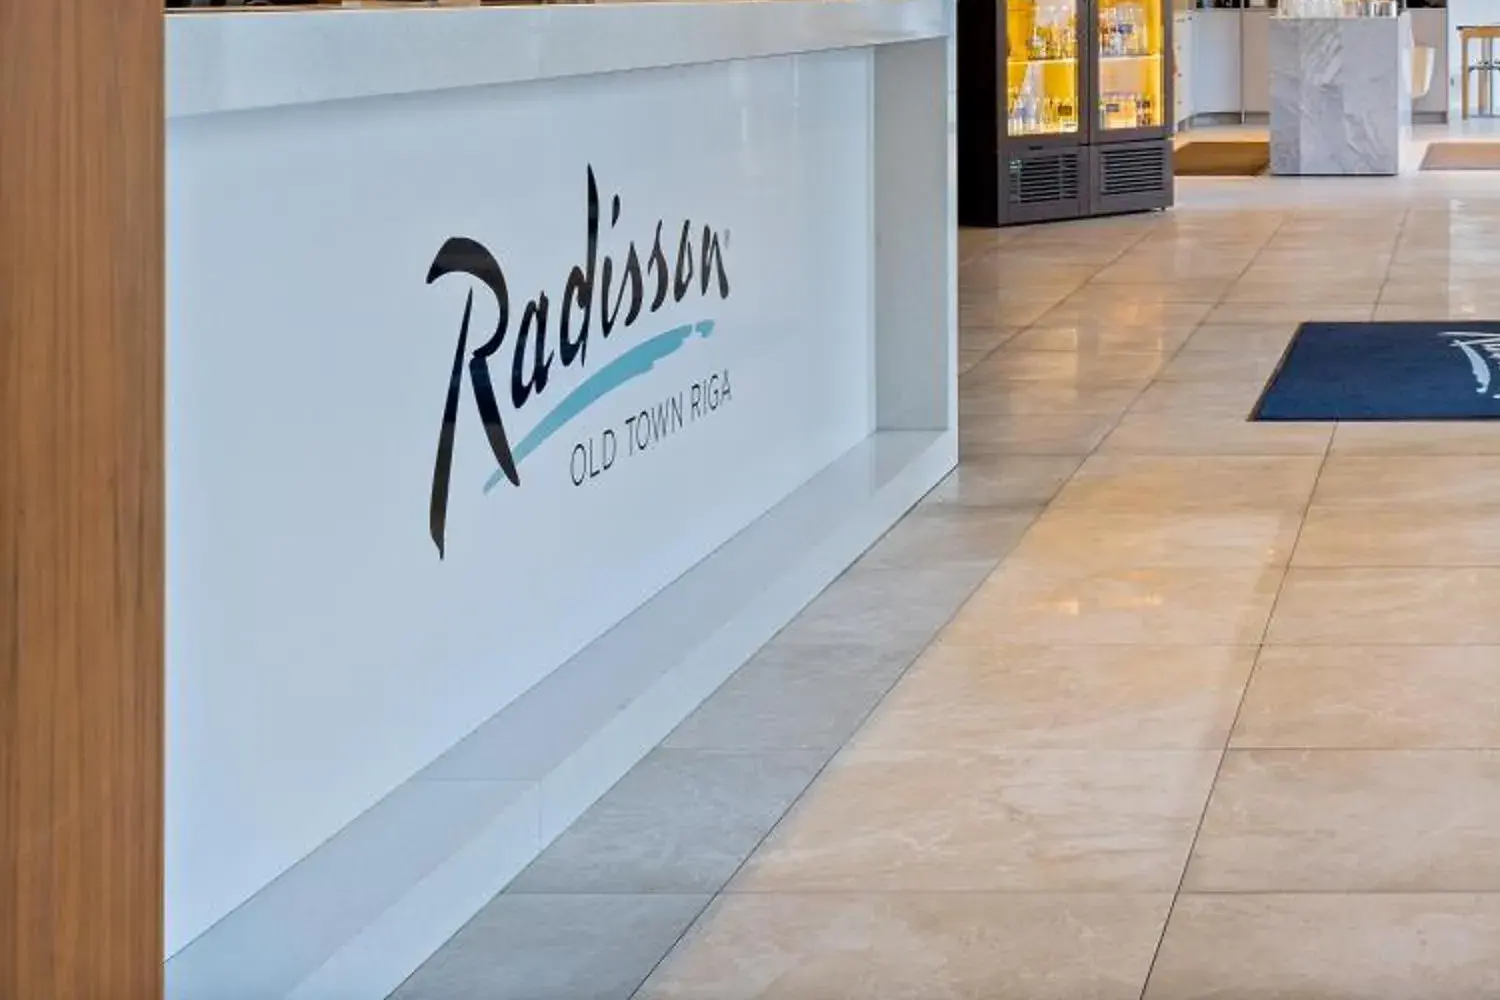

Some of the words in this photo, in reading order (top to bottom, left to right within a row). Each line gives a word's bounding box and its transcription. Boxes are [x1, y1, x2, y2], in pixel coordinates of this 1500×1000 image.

[426, 163, 730, 560] Radisson
[570, 429, 617, 486] OLD
[624, 391, 683, 456] TOWN
[690, 368, 732, 422] RIGA
